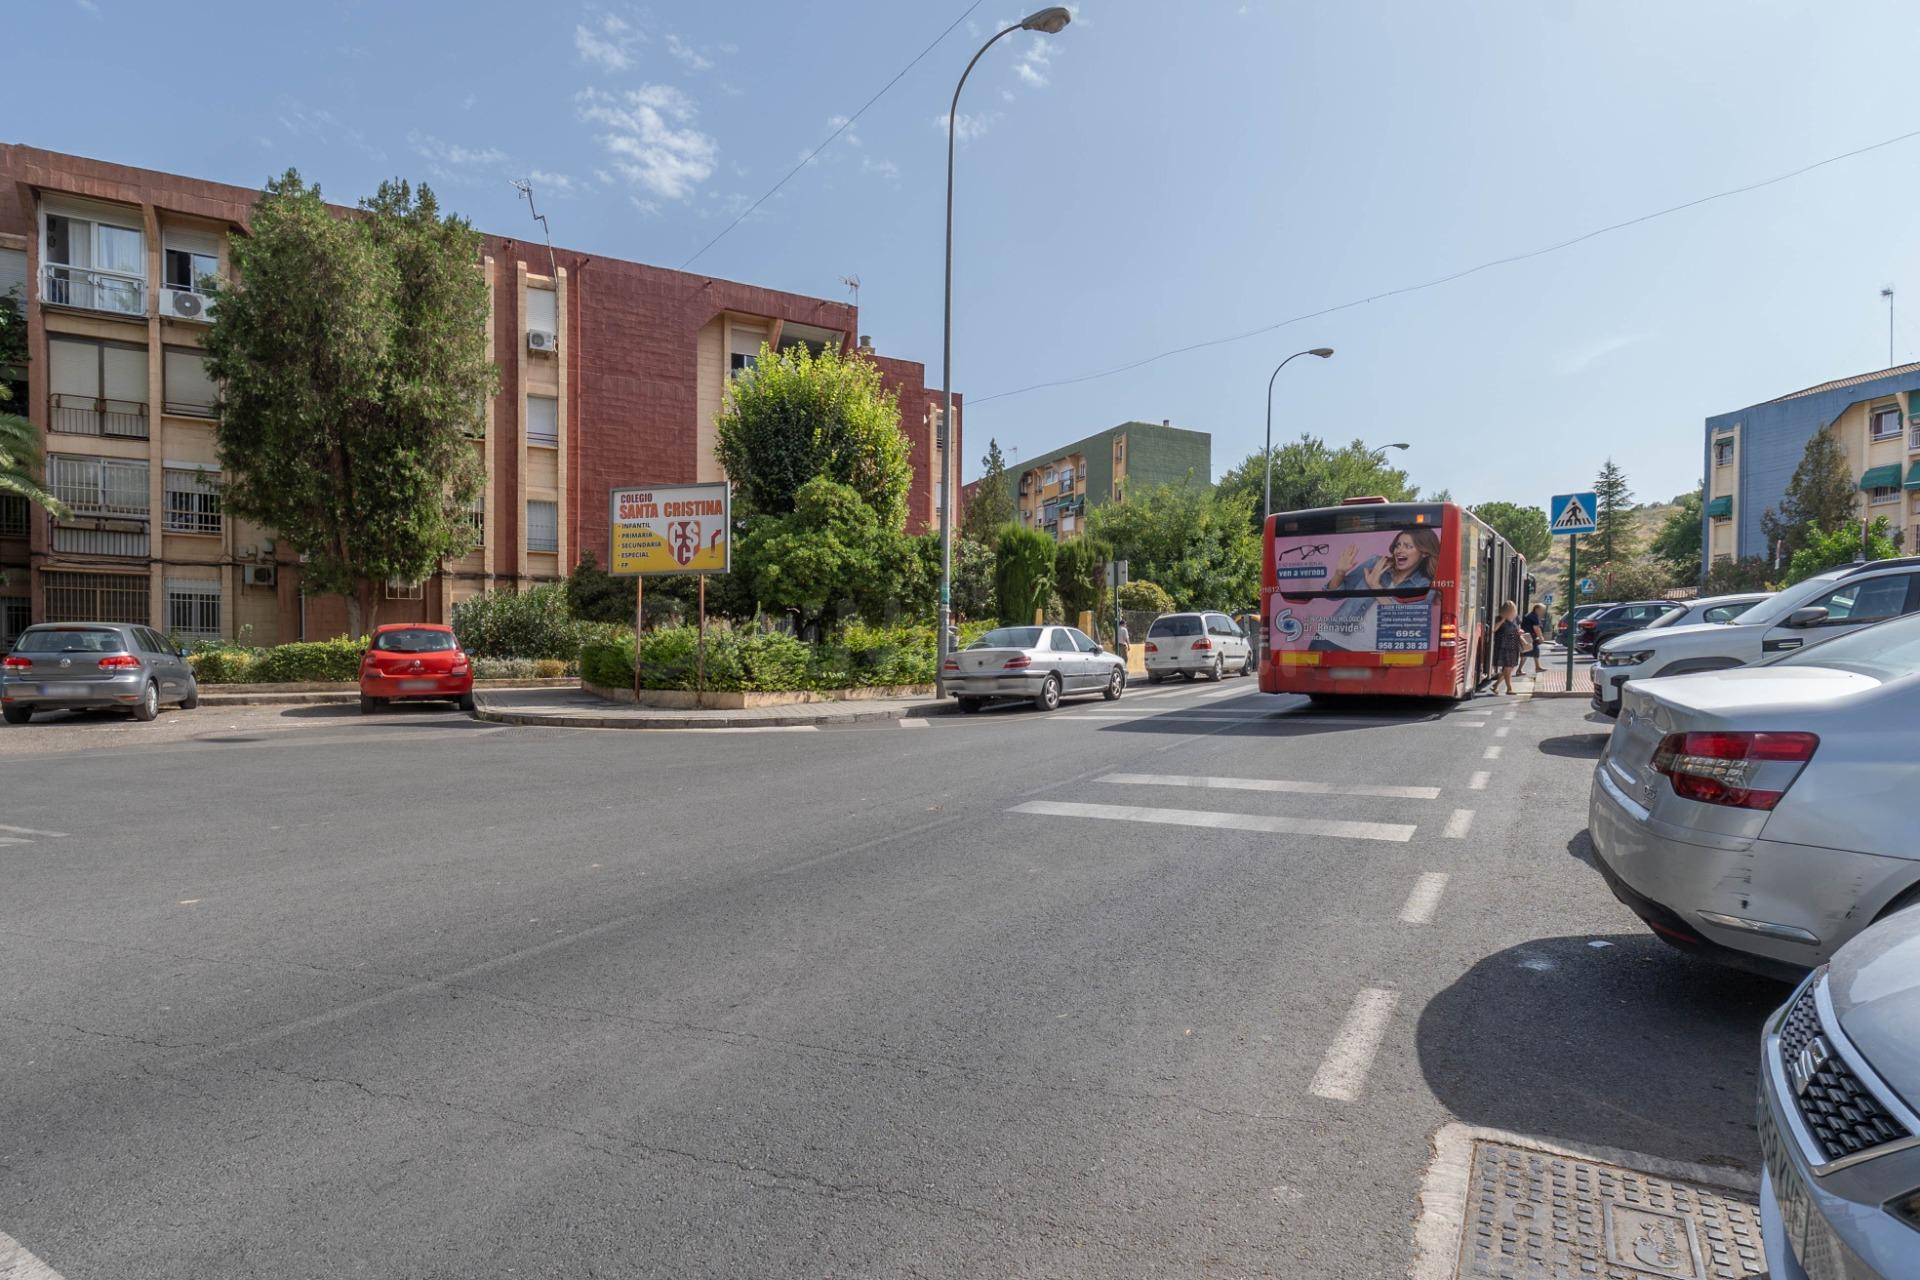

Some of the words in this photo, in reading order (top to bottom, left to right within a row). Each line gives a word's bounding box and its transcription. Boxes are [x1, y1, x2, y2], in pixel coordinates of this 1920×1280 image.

[620, 493, 653, 503] COLEGIO
[619, 503, 659, 520] SANTA
[663, 499, 723, 518] CRISTINA
[621, 541, 662, 549] SECUNDARIA
[1395, 630, 1422, 638] 695€
[1377, 642, 1393, 650] 958
[1394, 642, 1405, 650] 28
[1406, 642, 1417, 650] 38
[1417, 642, 1428, 650] 28
